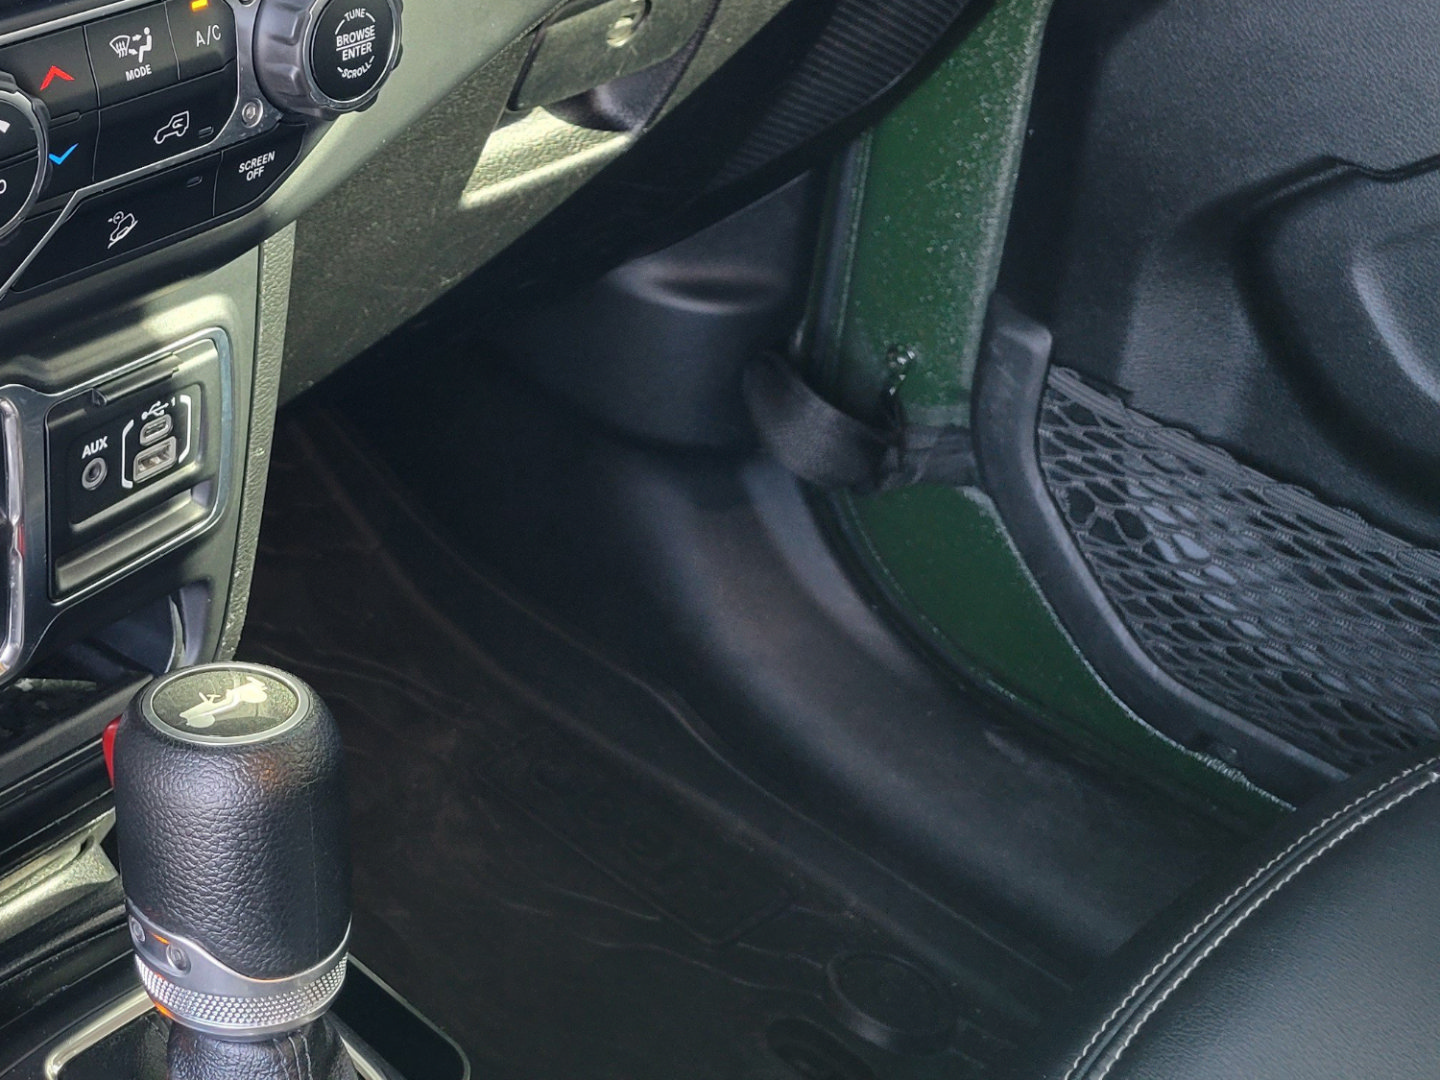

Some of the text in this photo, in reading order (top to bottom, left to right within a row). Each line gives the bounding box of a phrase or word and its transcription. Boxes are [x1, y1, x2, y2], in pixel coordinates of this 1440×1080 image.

[344, 8, 366, 22] TUNE
[196, 24, 222, 48] A/C
[336, 24, 376, 47] BROWSE
[342, 41, 372, 61] ENTER
[125, 63, 153, 82] MODE
[341, 62, 372, 79] SCROLL
[238, 150, 276, 174] SCREEN
[246, 165, 265, 182] OFF
[81, 436, 109, 459] AUX
